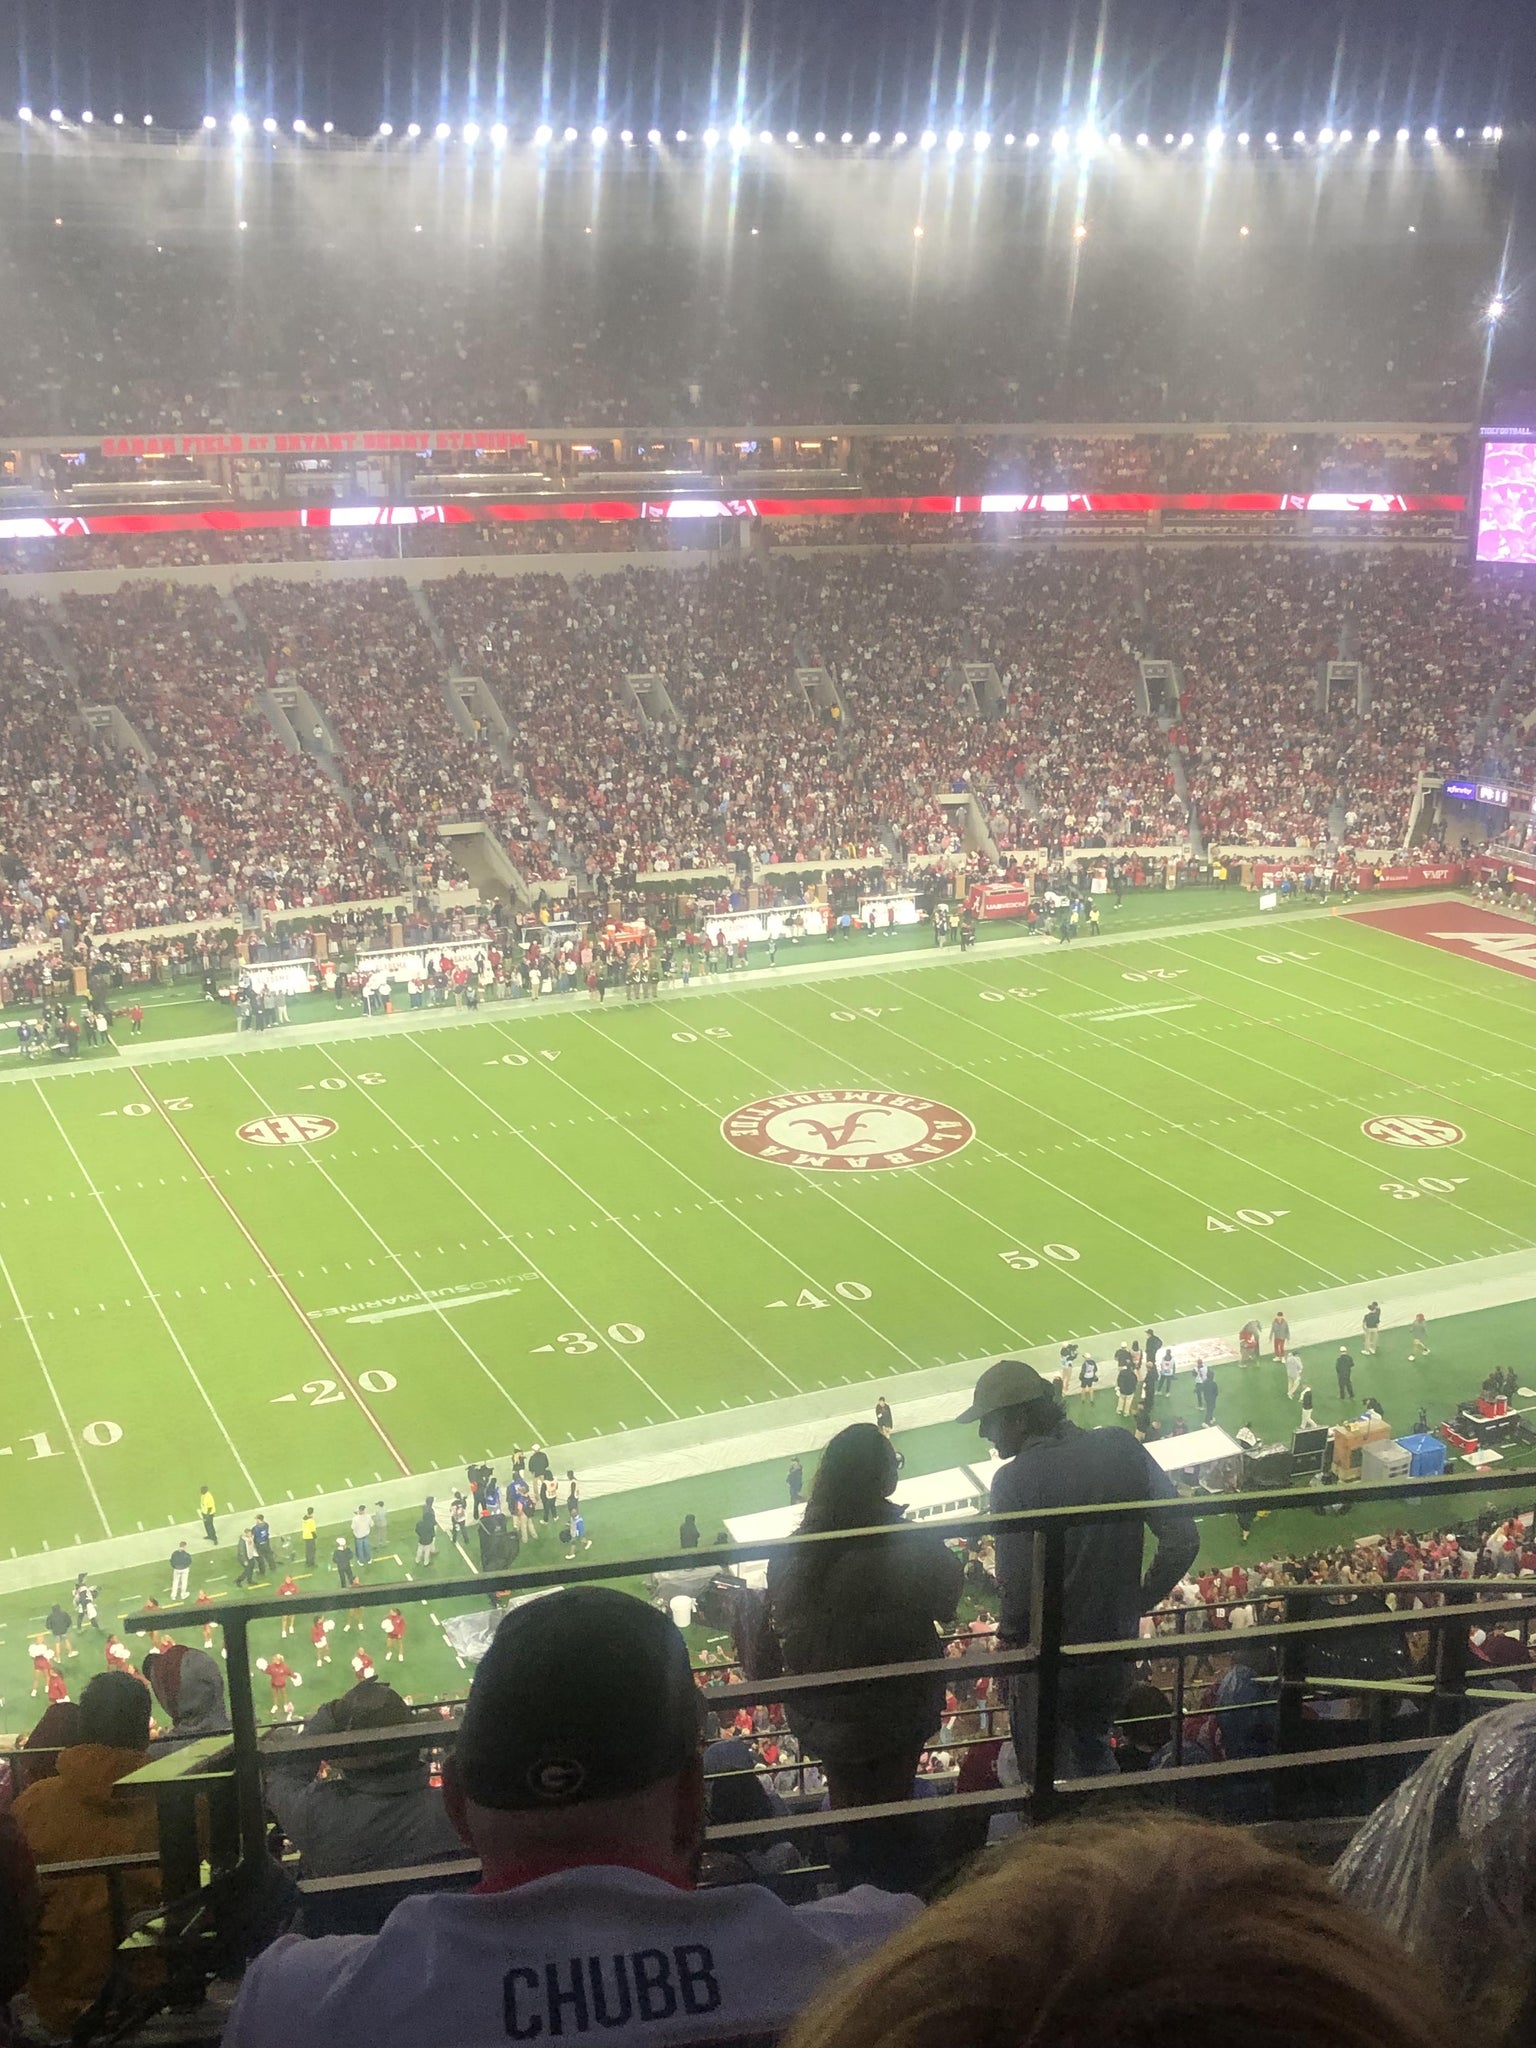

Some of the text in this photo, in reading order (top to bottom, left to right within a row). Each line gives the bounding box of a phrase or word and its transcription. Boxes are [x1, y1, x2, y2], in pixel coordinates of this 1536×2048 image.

[436, 432, 526, 448] STADIUM
[1446, 785, 1473, 796] xfinity
[1121, 968, 1178, 982] 20
[978, 987, 1038, 1002] 30
[829, 1006, 883, 1022] 40
[671, 1027, 733, 1043] 50
[501, 1050, 562, 1066] 40
[319, 1072, 387, 1090] 30
[122, 1097, 194, 1117] 20
[730, 1092, 934, 1137] CRIMSON TIDE
[238, 1115, 335, 1144] SEC
[788, 1109, 892, 1150] A
[1368, 1117, 1459, 1147] SEC
[758, 1120, 963, 1168] ALABAMA
[1379, 1177, 1456, 1200] 30
[1206, 1209, 1275, 1234] 40
[998, 1243, 1081, 1270] 50
[796, 1281, 873, 1309] 40
[557, 1323, 646, 1354] 30
[302, 1370, 398, 1406] 20
[19, 1421, 124, 1461] 10
[503, 1944, 722, 2041] CHUBB
